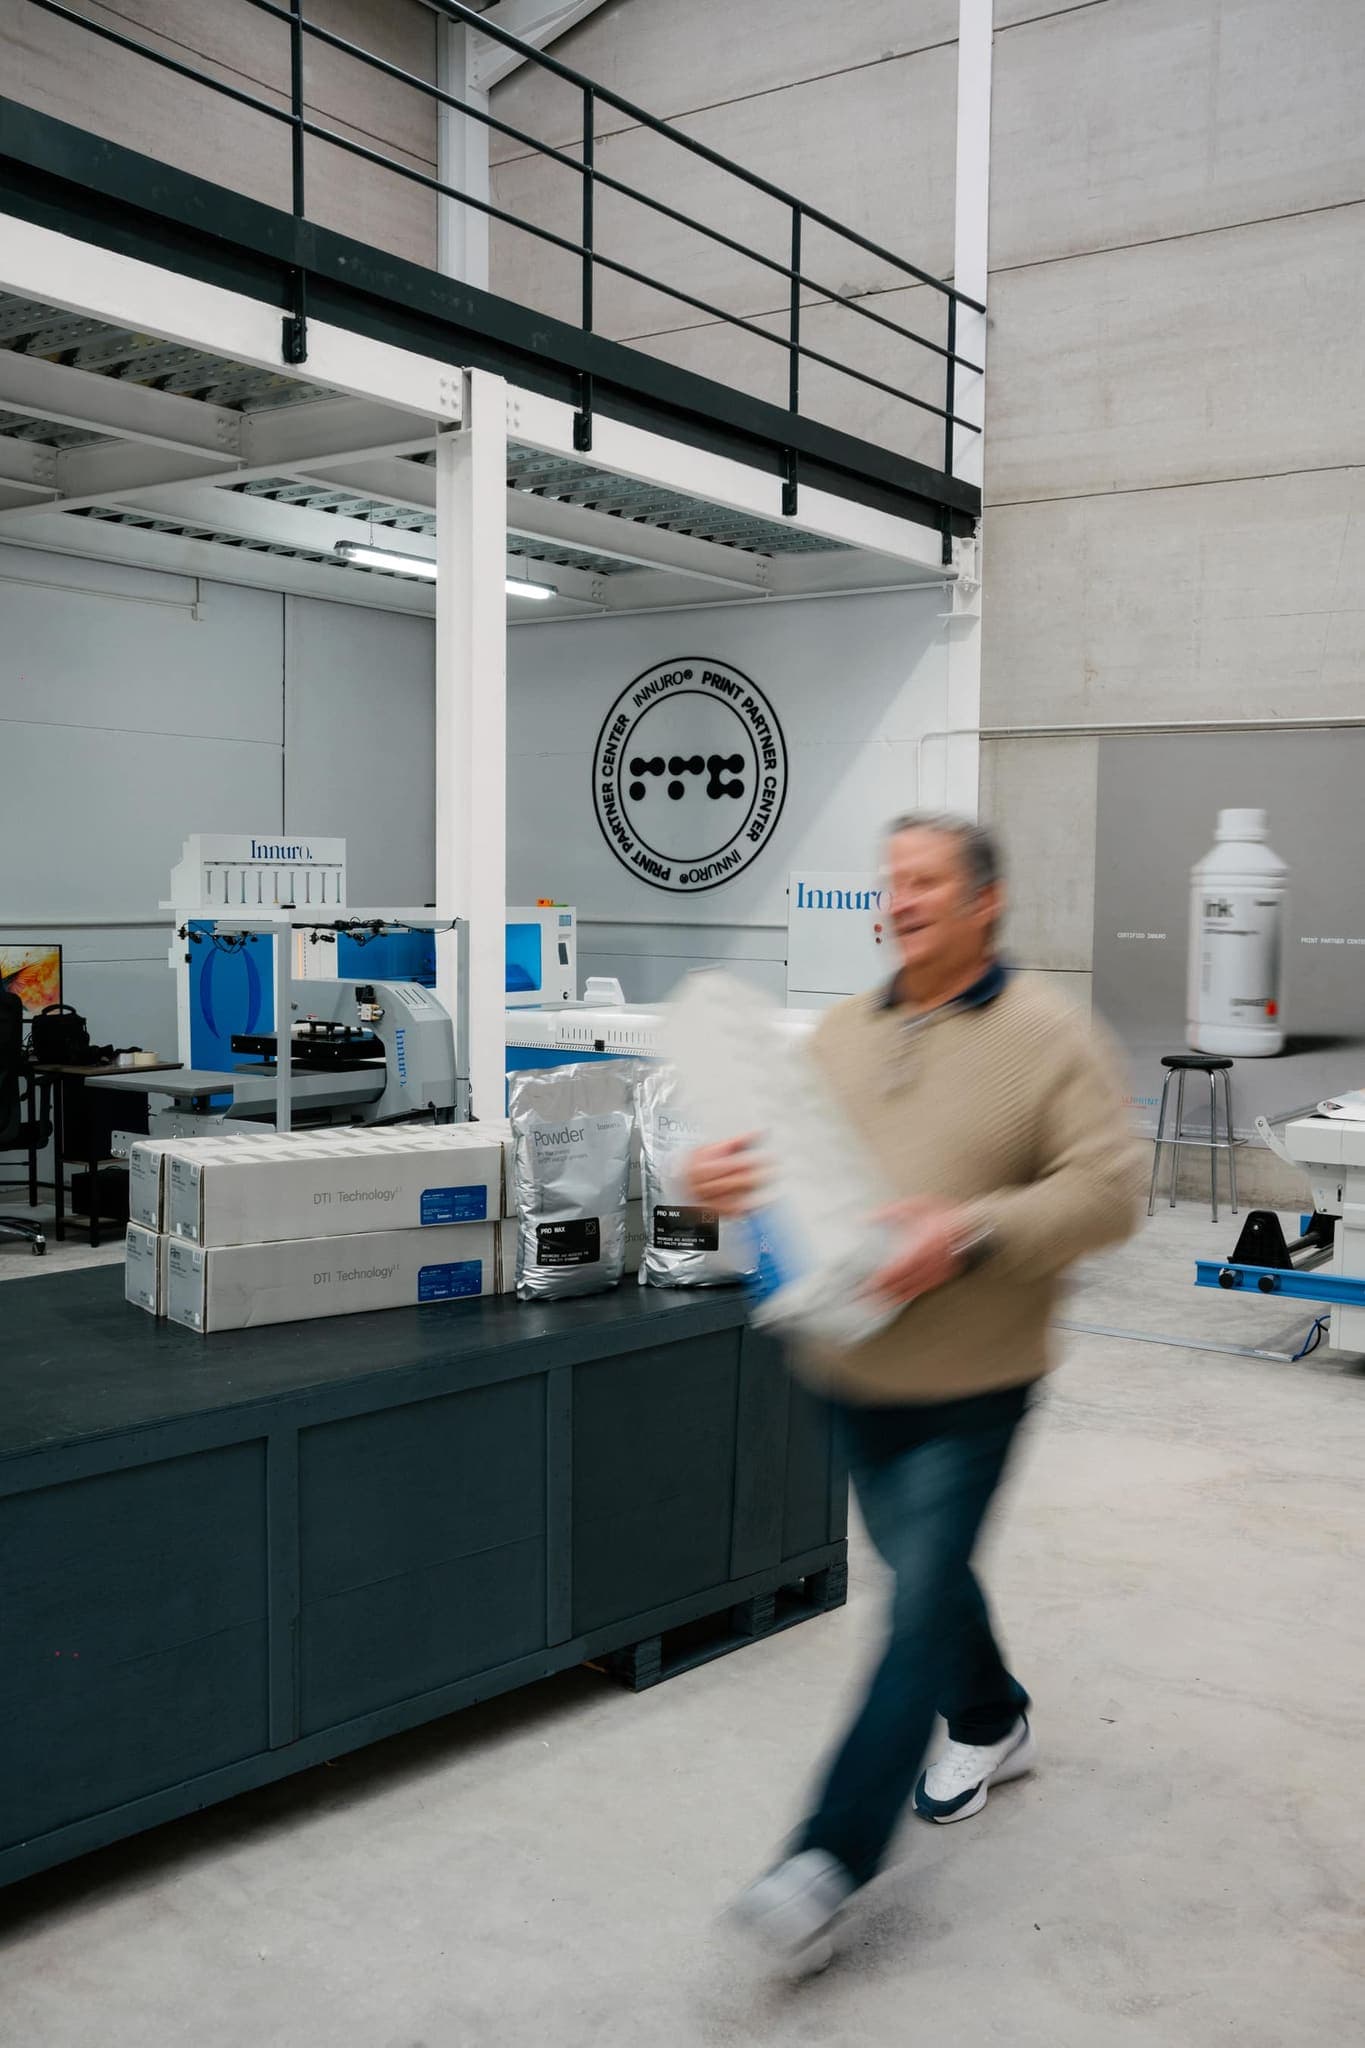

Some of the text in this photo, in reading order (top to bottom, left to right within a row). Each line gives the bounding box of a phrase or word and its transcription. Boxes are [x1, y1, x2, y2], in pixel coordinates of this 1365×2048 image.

[701, 670, 745, 700] PRINT
[602, 713, 630, 777] CENTER
[740, 696, 777, 770] PARTNER
[602, 782, 634, 853] PARTNER
[746, 776, 777, 842] CENTER
[631, 851, 671, 881] PRINT
[534, 1126, 585, 1147] Powder
[313, 1192, 332, 1205] DTI
[313, 1271, 331, 1285] DTI
